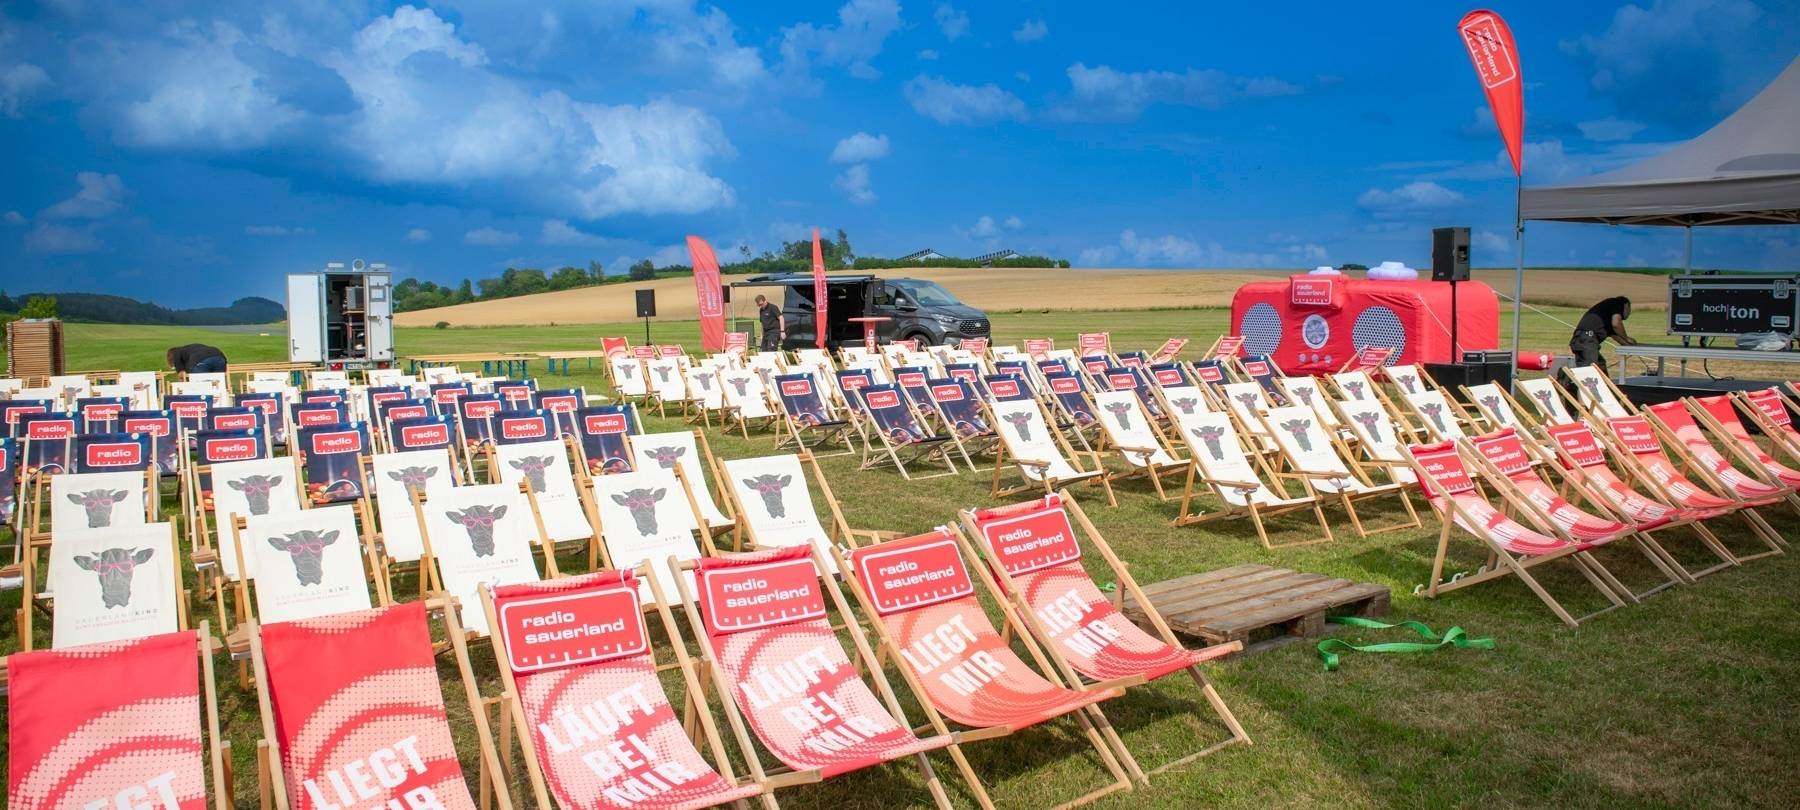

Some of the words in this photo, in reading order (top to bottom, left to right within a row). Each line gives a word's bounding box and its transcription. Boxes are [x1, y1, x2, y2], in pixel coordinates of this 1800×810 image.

[1483, 27, 1498, 52] radio
[1475, 31, 1500, 76] sauerland
[1702, 304, 1726, 312] hoch
[1730, 305, 1760, 319] ton
[37, 425, 66, 433] radio
[412, 431, 440, 440] radio
[594, 420, 619, 428] radio
[97, 449, 132, 458] radio
[216, 444, 248, 453] radio
[322, 437, 352, 446] radio
[998, 528, 1032, 542] radio
[1003, 532, 1065, 556] sauerland
[879, 560, 918, 577] radio
[884, 565, 956, 590] sauerland
[722, 577, 768, 593] radio
[726, 585, 810, 608] sauerland
[521, 610, 576, 628] radio
[524, 618, 625, 645] sauerland
[1063, 619, 1121, 659] MIR
[901, 614, 978, 676] LIEGT
[739, 645, 840, 710] LÄUFT
[938, 650, 1007, 697] MIR
[537, 681, 656, 755] LÄUFT
[782, 690, 845, 732] BEI
[804, 714, 888, 756] MIR
[582, 733, 658, 782] BEI
[604, 760, 698, 807] MIR
